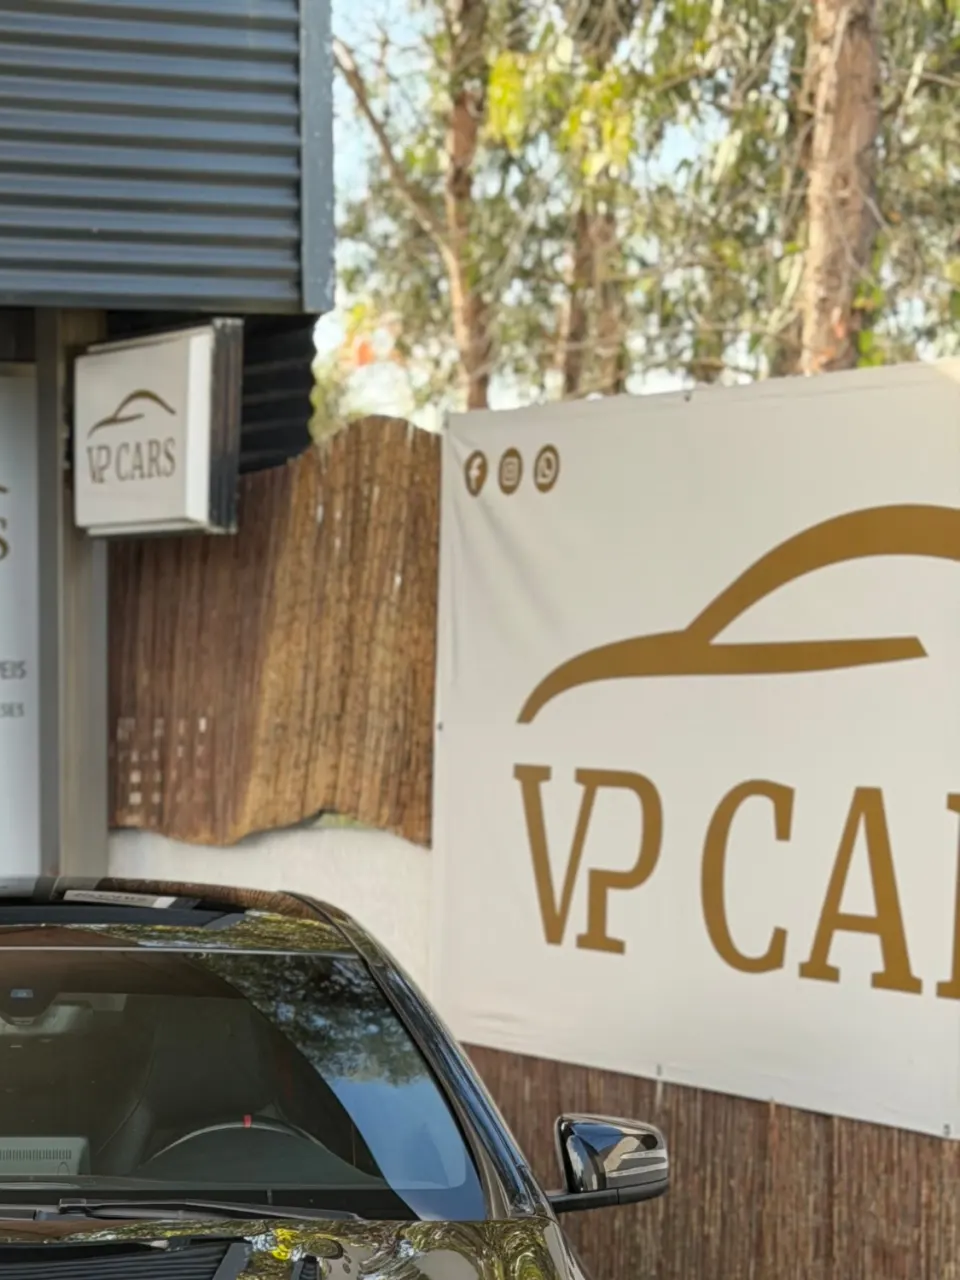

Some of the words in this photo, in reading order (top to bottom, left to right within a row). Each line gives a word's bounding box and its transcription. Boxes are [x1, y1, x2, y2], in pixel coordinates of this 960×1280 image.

[86, 444, 112, 484] VP
[115, 436, 176, 481] CARS
[513, 762, 664, 955] VP
[700, 779, 960, 1000] CA
